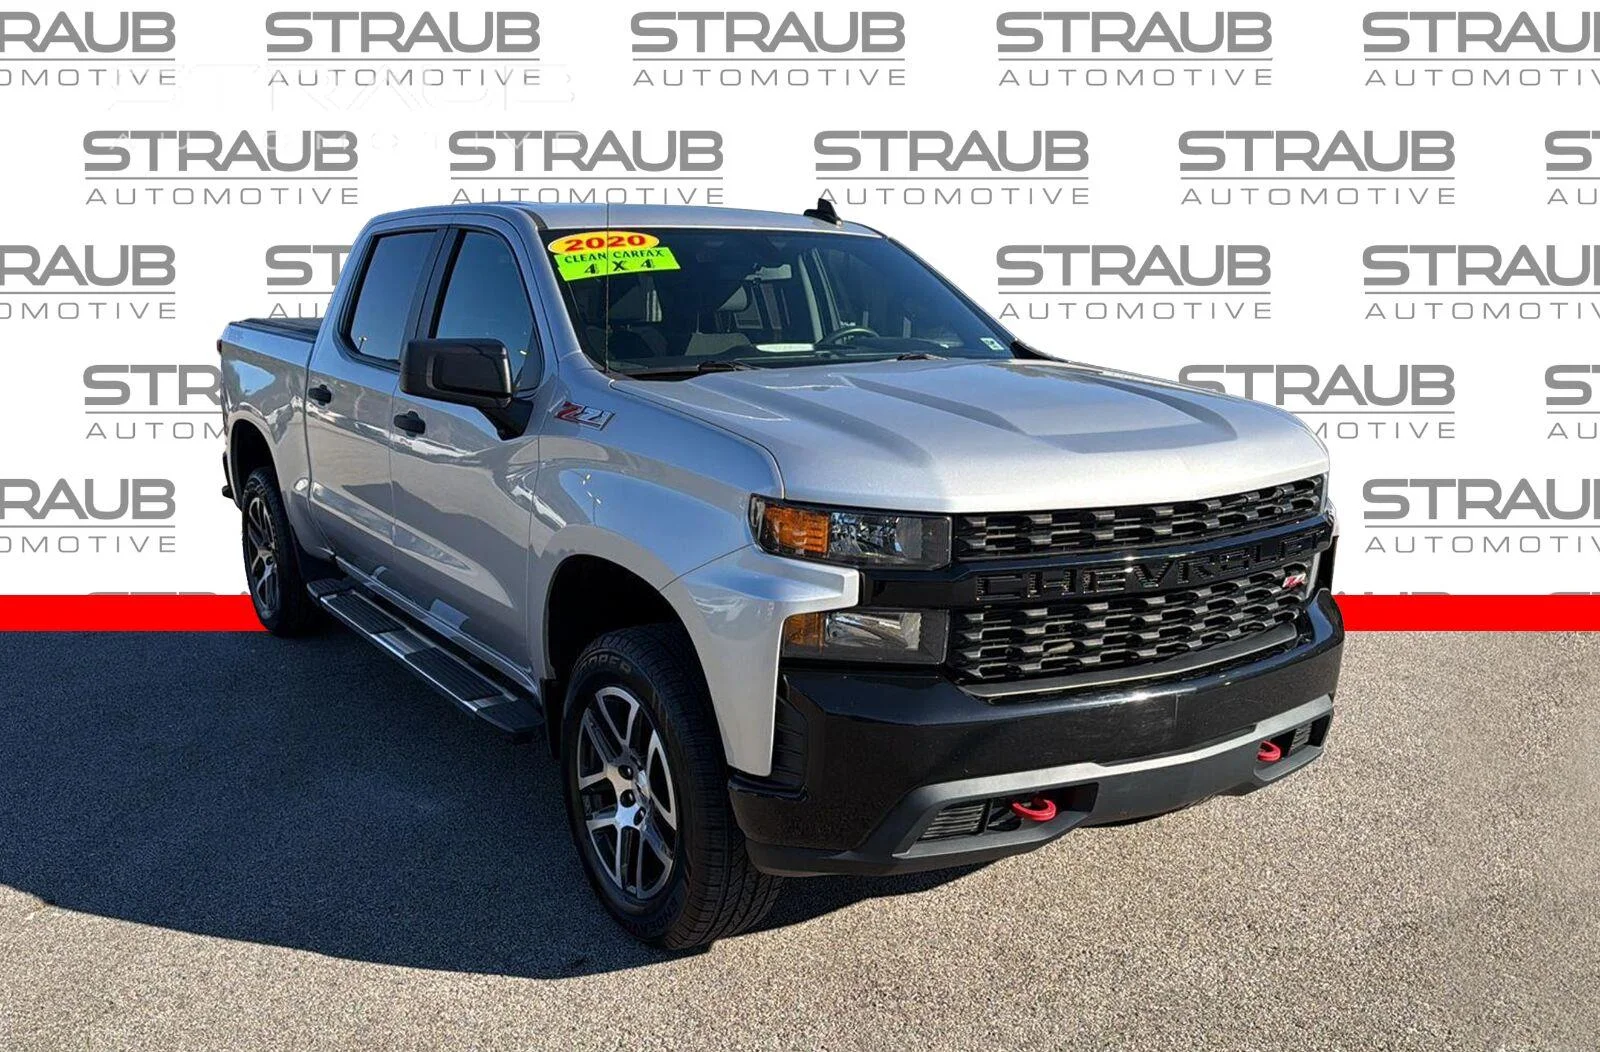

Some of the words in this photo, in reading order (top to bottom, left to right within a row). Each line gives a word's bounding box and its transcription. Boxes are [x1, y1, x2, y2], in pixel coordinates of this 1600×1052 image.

[564, 235, 646, 252] 2020
[564, 252, 607, 264] CLEAN
[613, 249, 665, 259] CARFAX
[584, 263, 600, 275] 4
[641, 258, 656, 269] 4
[554, 400, 616, 431] Z71
[976, 530, 1326, 600] CHEVROLET
